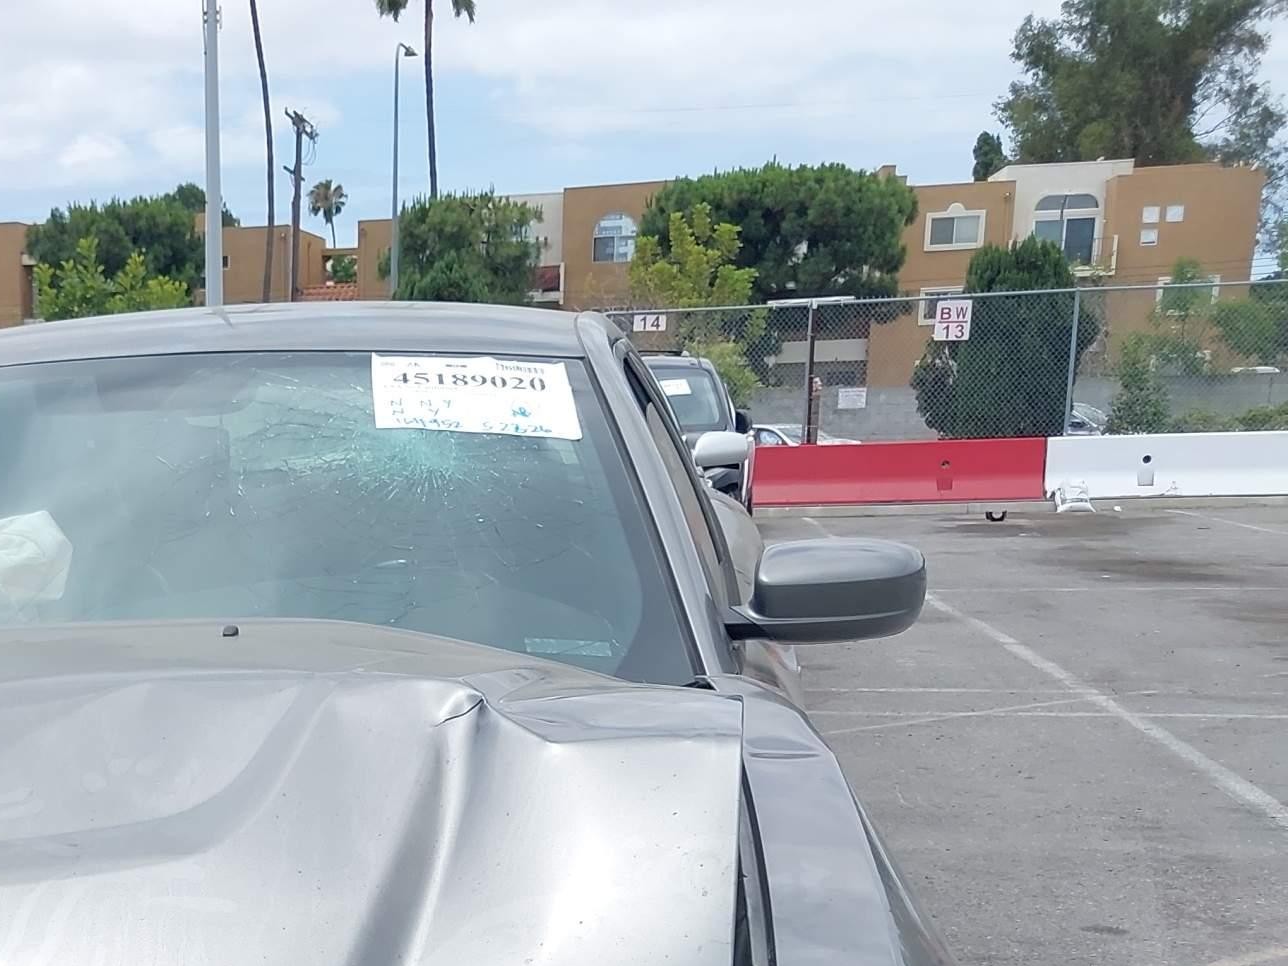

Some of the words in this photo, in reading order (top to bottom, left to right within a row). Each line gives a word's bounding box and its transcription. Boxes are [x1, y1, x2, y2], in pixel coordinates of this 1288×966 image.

[940, 306, 968, 320] BW
[640, 315, 661, 330] 14
[942, 324, 965, 339] 13
[393, 372, 546, 391] 45189020
